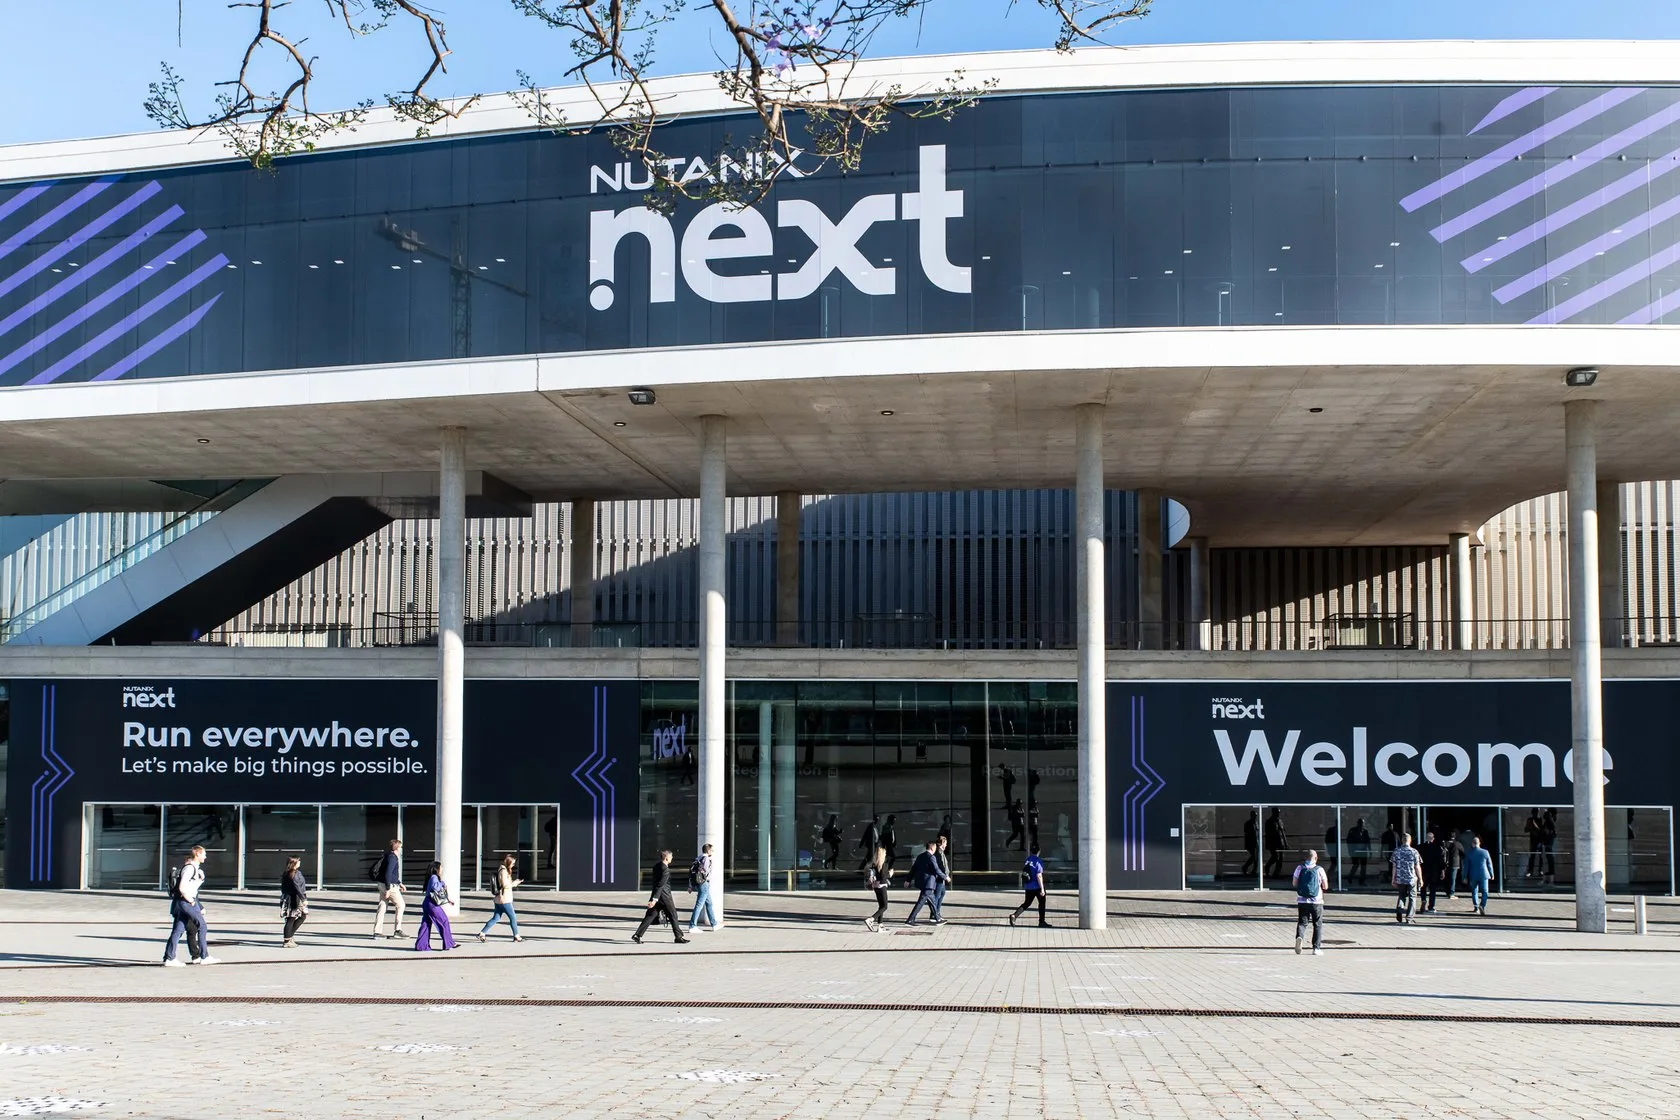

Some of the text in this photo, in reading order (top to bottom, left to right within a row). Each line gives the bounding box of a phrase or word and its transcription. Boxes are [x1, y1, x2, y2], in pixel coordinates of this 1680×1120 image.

[590, 149, 807, 193] NUTANIX
[123, 721, 419, 754] Run everywhere.
[122, 756, 428, 777] Let’s make big things possible.
